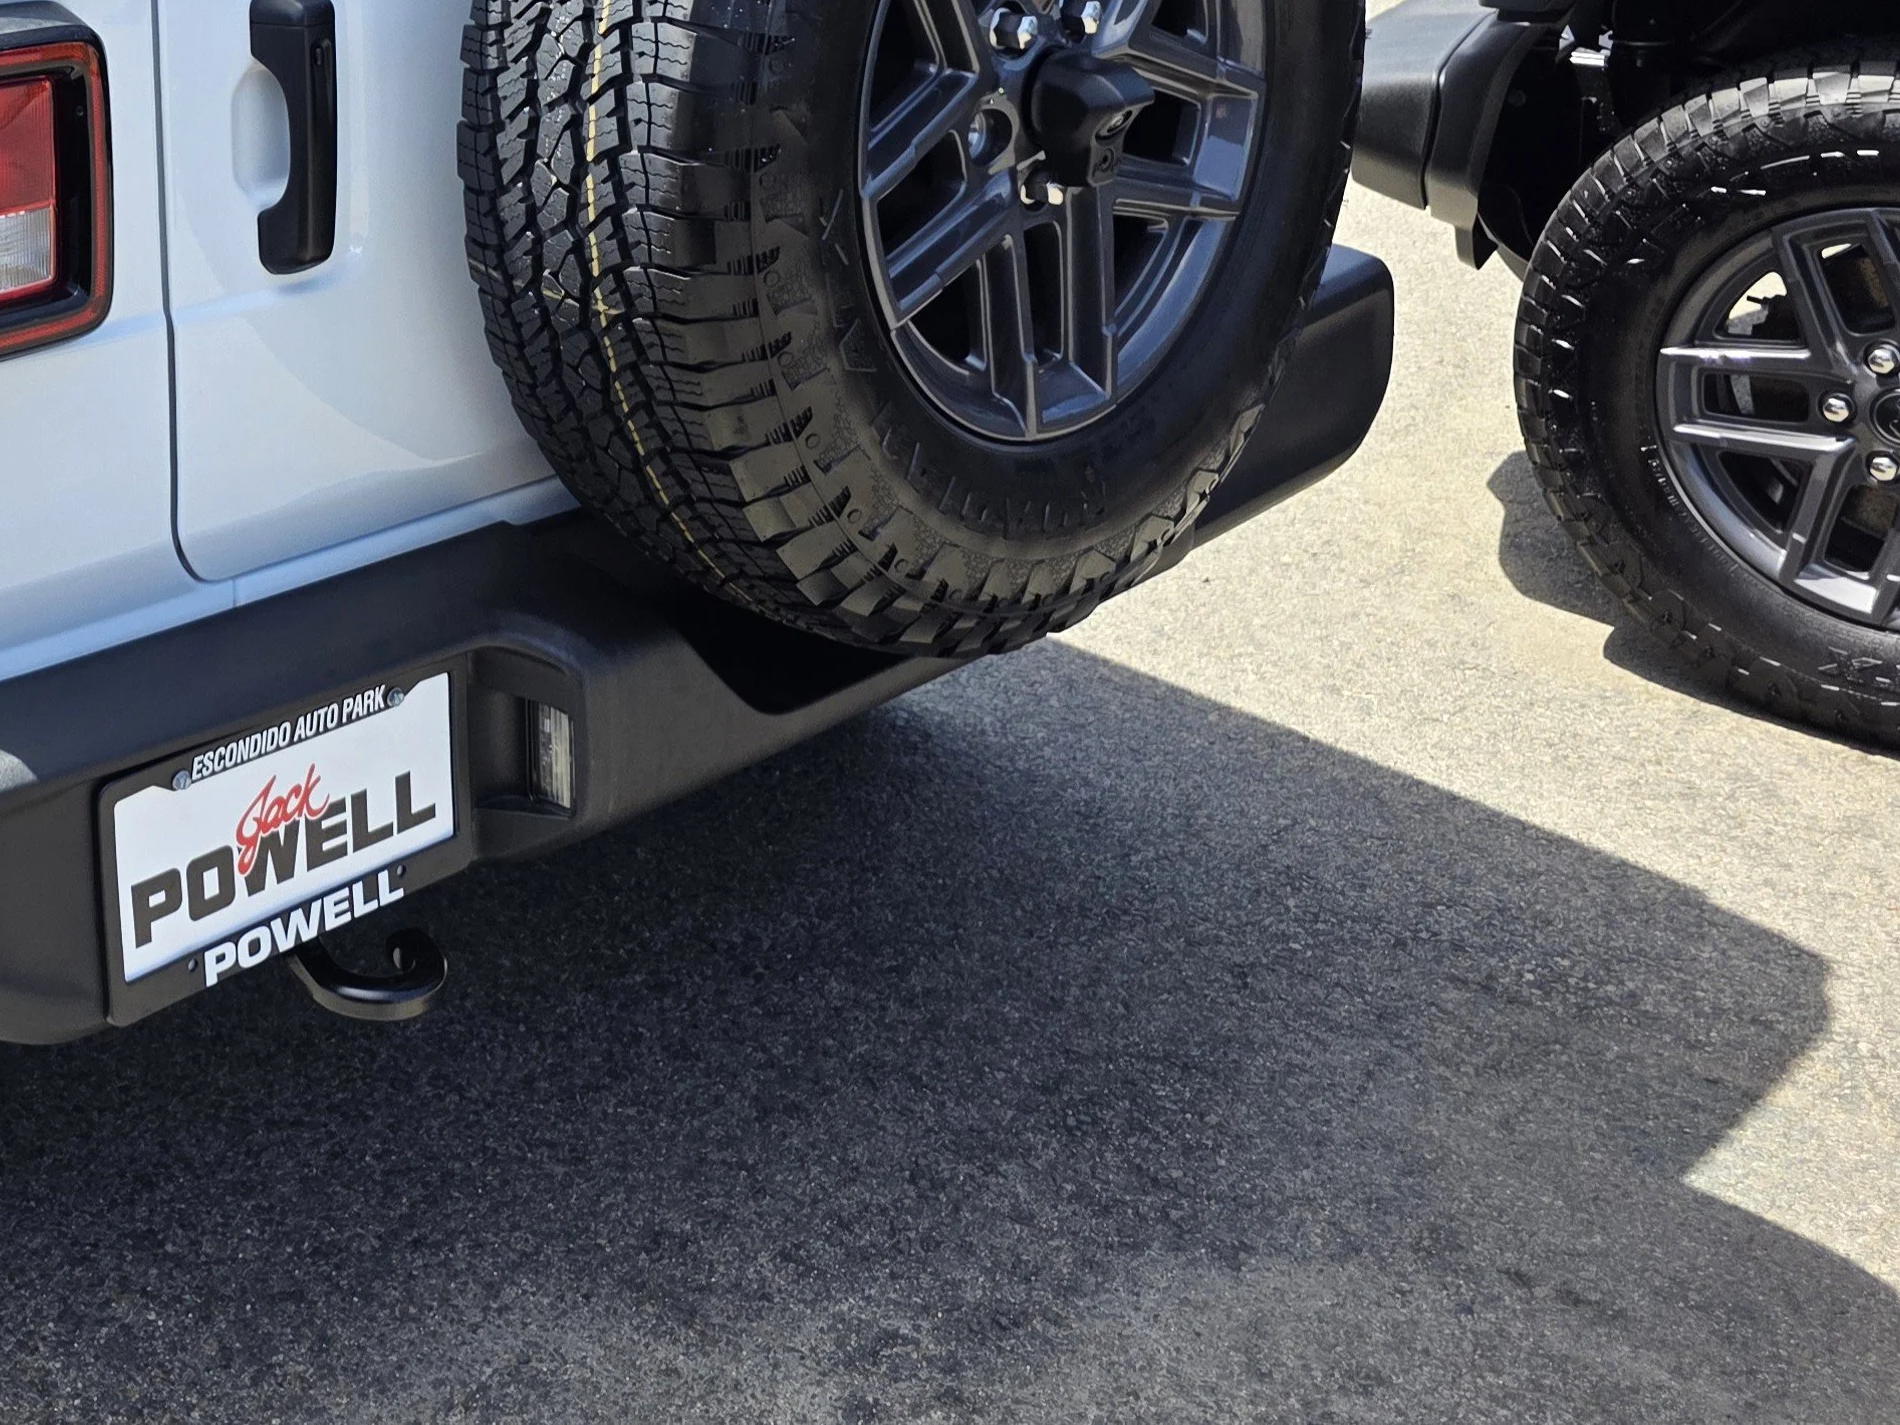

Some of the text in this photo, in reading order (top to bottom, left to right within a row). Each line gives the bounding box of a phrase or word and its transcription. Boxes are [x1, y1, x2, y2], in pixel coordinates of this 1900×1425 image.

[191, 684, 386, 781] ESCONDIDO AUTO PARK
[131, 771, 436, 950] POWELL
[236, 763, 330, 875] Jack
[205, 869, 405, 988] POWELL
